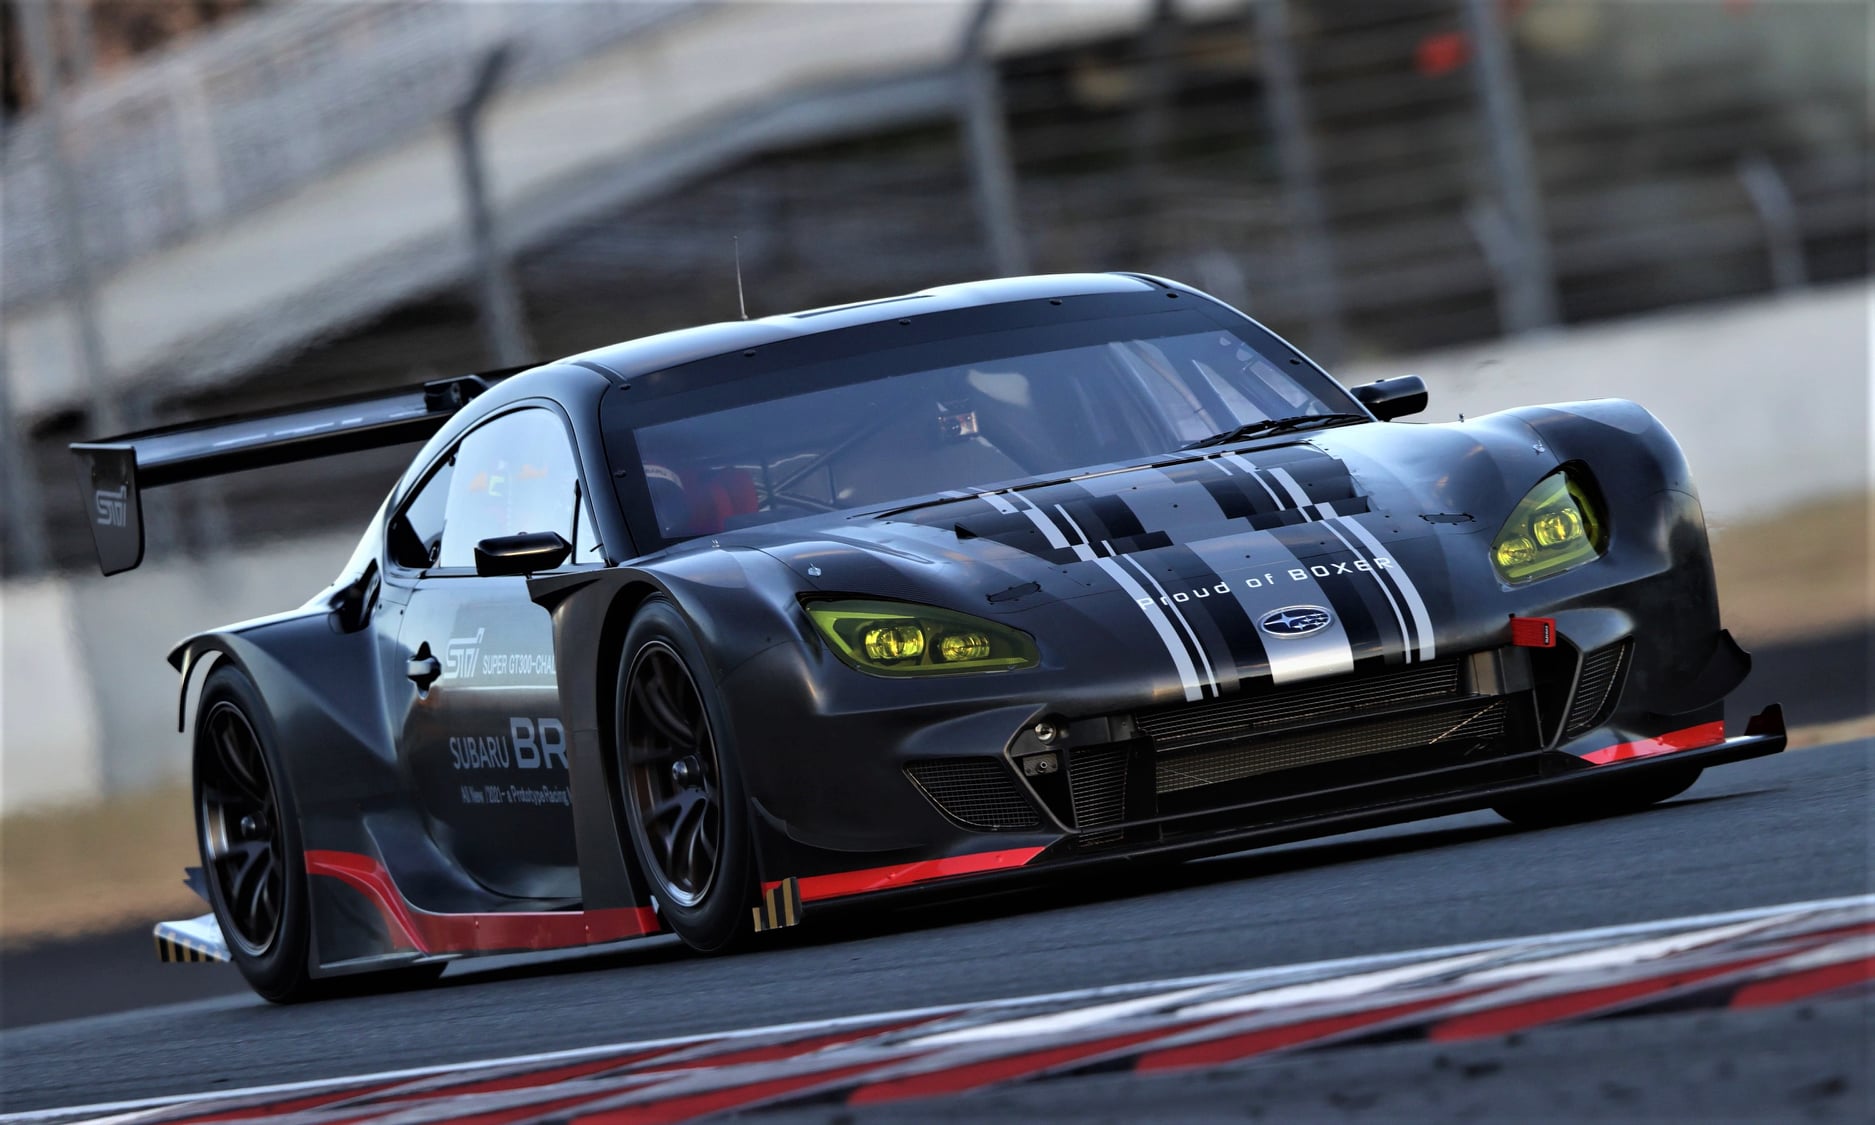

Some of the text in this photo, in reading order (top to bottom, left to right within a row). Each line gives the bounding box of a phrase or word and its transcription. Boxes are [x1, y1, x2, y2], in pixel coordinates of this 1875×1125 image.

[1137, 556, 1395, 611] Proud of BOXER
[482, 654, 508, 675] SUPER
[450, 717, 569, 770] SUBARU BR
